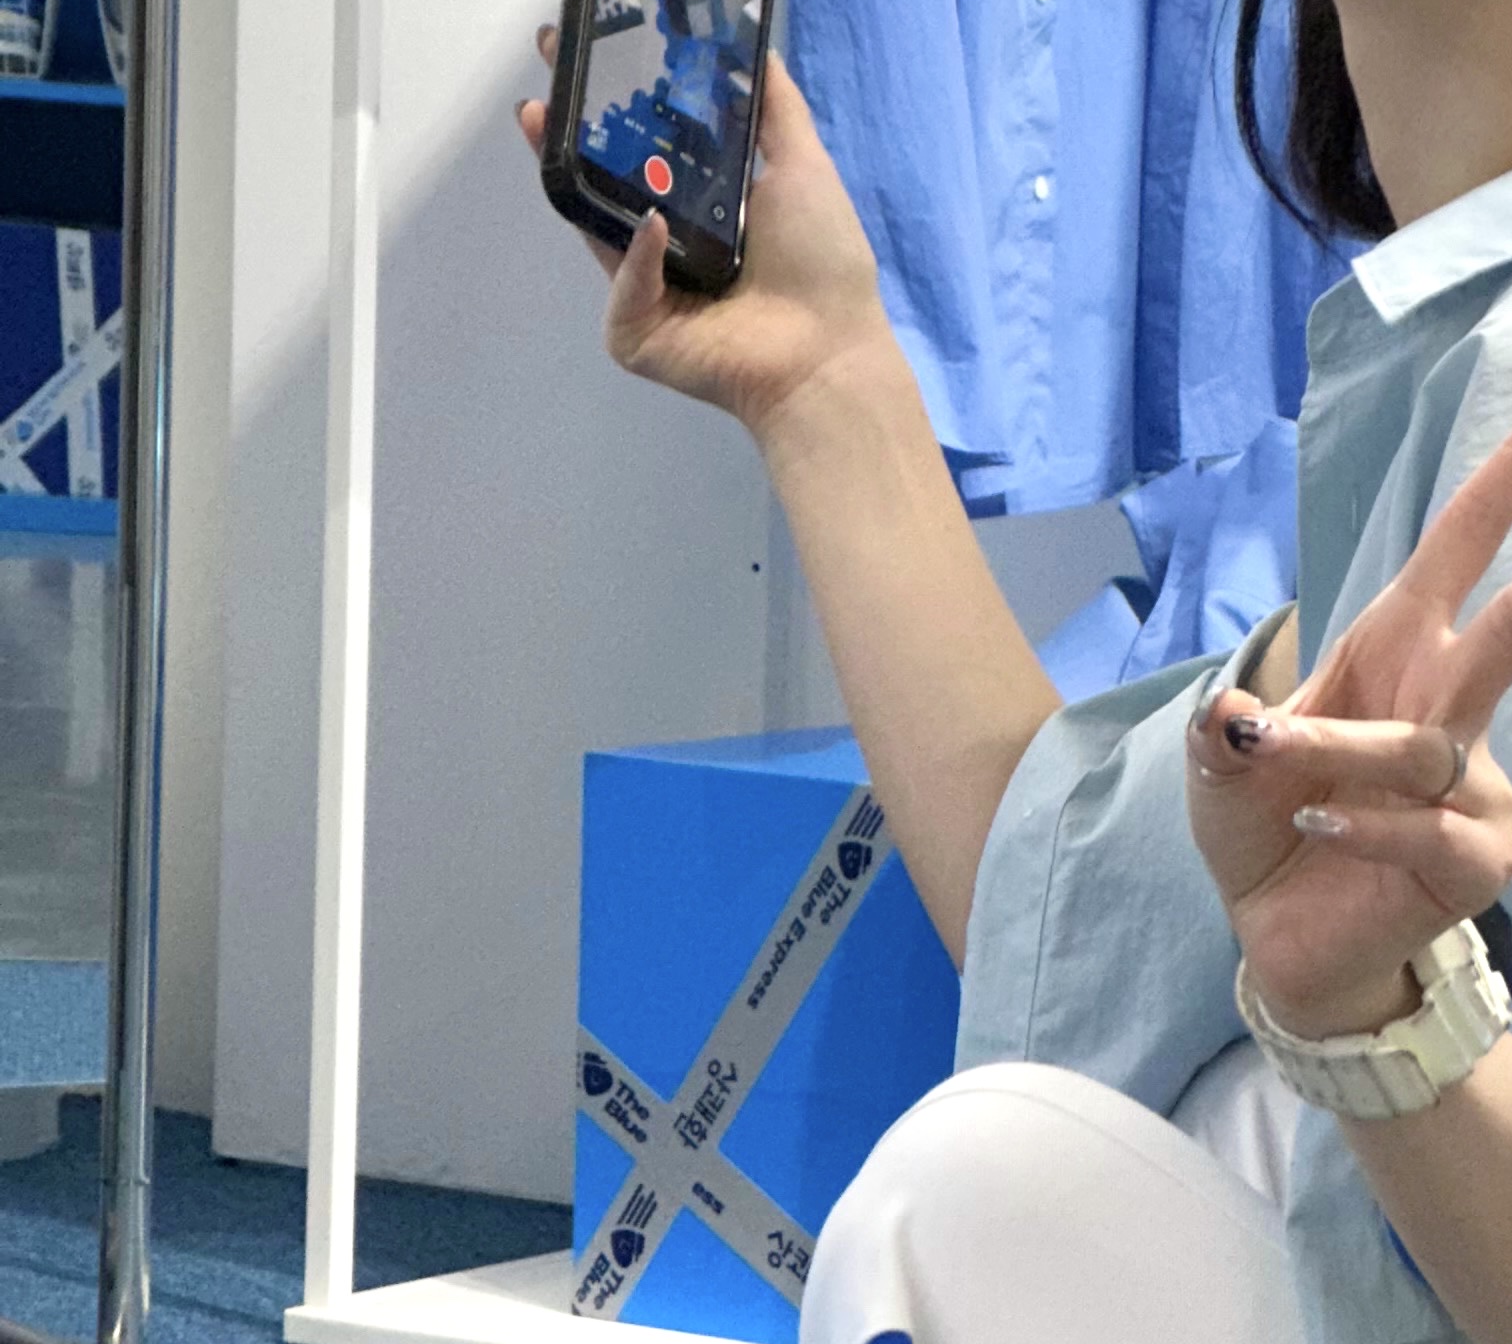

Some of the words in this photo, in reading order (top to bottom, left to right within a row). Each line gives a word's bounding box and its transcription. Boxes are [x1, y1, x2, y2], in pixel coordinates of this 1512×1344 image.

[802, 865, 837, 918] Blue
[820, 882, 851, 925] The
[747, 916, 806, 1009] Express
[604, 1097, 648, 1143] Blue
[616, 1079, 650, 1121] The
[673, 1059, 737, 1150] 상쾌환
[575, 1251, 610, 1303] Blue
[594, 1269, 624, 1310] The
